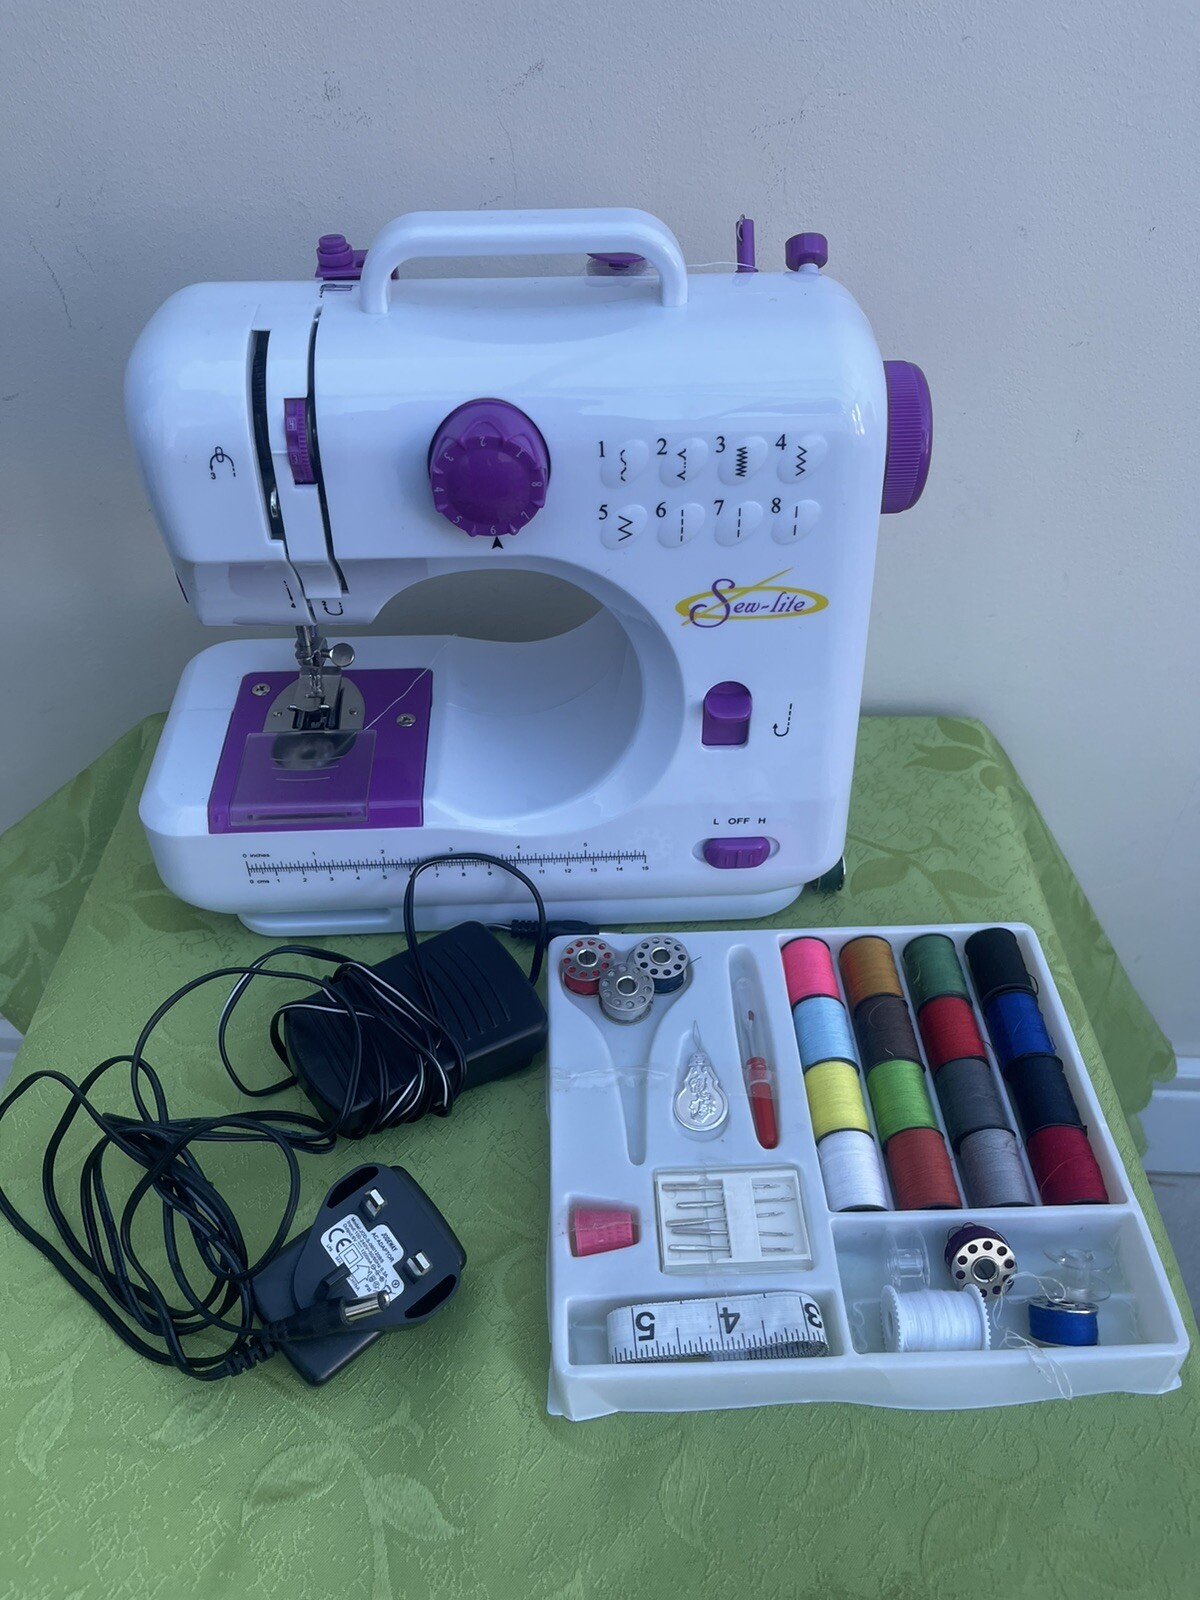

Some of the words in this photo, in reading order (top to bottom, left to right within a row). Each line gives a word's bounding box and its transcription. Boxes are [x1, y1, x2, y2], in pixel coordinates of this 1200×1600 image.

[479, 436, 487, 447] 2
[598, 440, 606, 458] 1
[656, 438, 668, 455] 2
[715, 435, 726, 453] 3
[775, 434, 787, 451] 4
[444, 452, 454, 462] 3
[515, 449, 524, 458] 1
[210, 472, 216, 480] 3
[598, 504, 608, 520] 5
[655, 501, 667, 518] 6
[713, 499, 724, 516] 7
[771, 497, 781, 514] 8
[452, 515, 463, 524] 5
[520, 511, 530, 520] 7
[490, 525, 497, 535] 6
[688, 578, 806, 629] Sew-lite
[713, 818, 720, 826] L
[728, 817, 750, 826] OFF
[758, 817, 766, 825] H
[635, 1311, 656, 1341] 5
[720, 1307, 741, 1334] 4
[804, 1302, 823, 1328] 3
